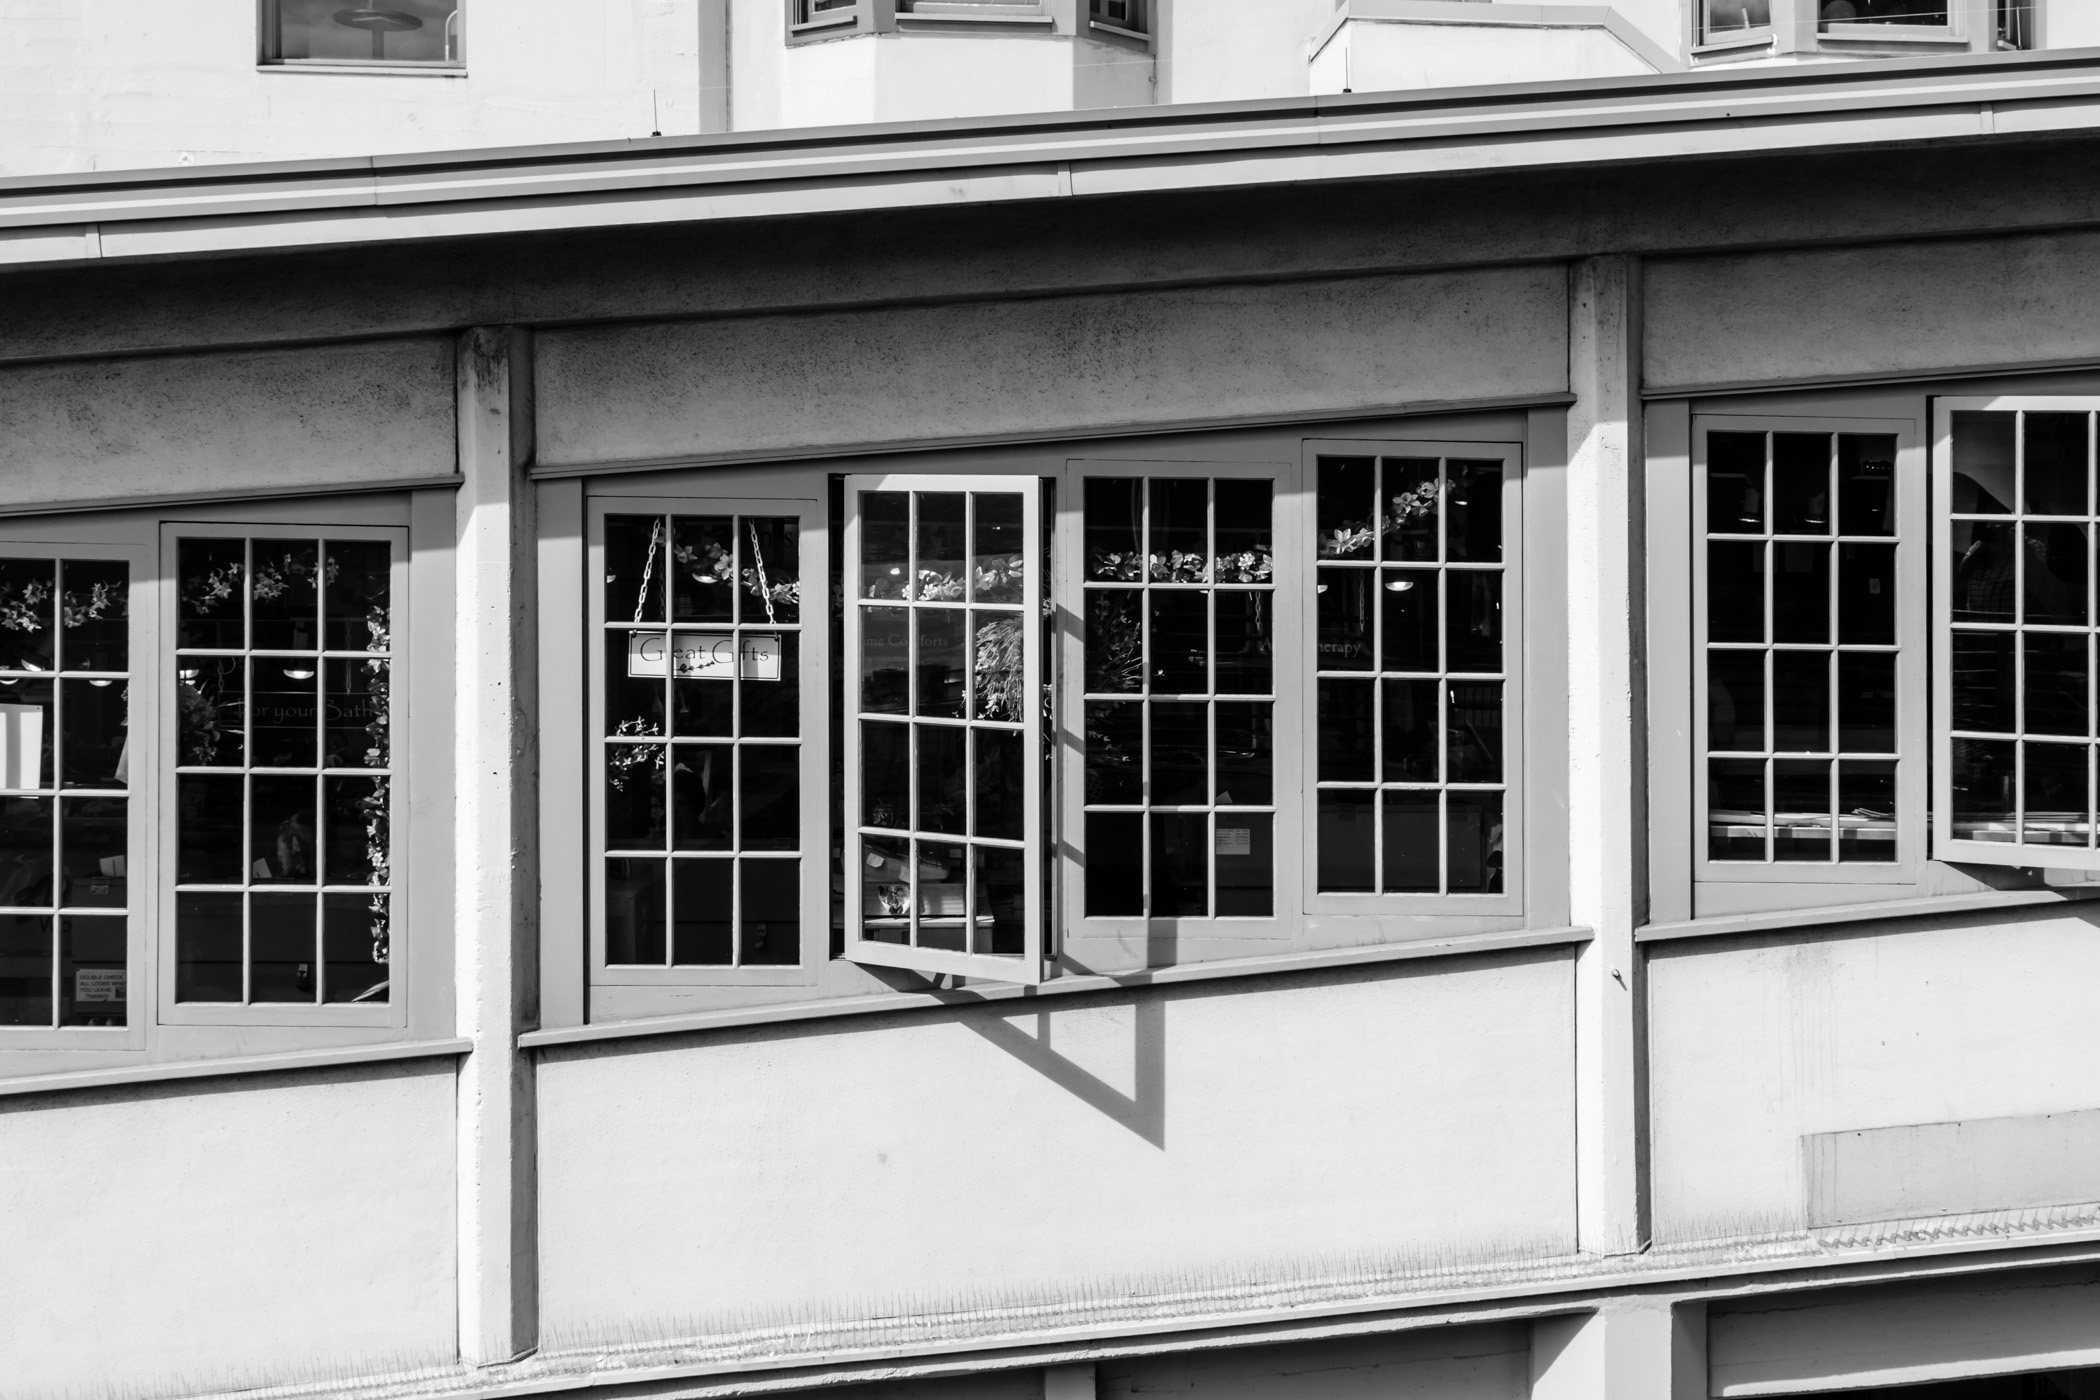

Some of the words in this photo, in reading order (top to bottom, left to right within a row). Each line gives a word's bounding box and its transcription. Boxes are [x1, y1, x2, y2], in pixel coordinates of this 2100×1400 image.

[888, 634, 948, 647] Coforts
[640, 637, 706, 662] Geat
[712, 639, 769, 664] Gfts
[273, 705, 318, 724] your
